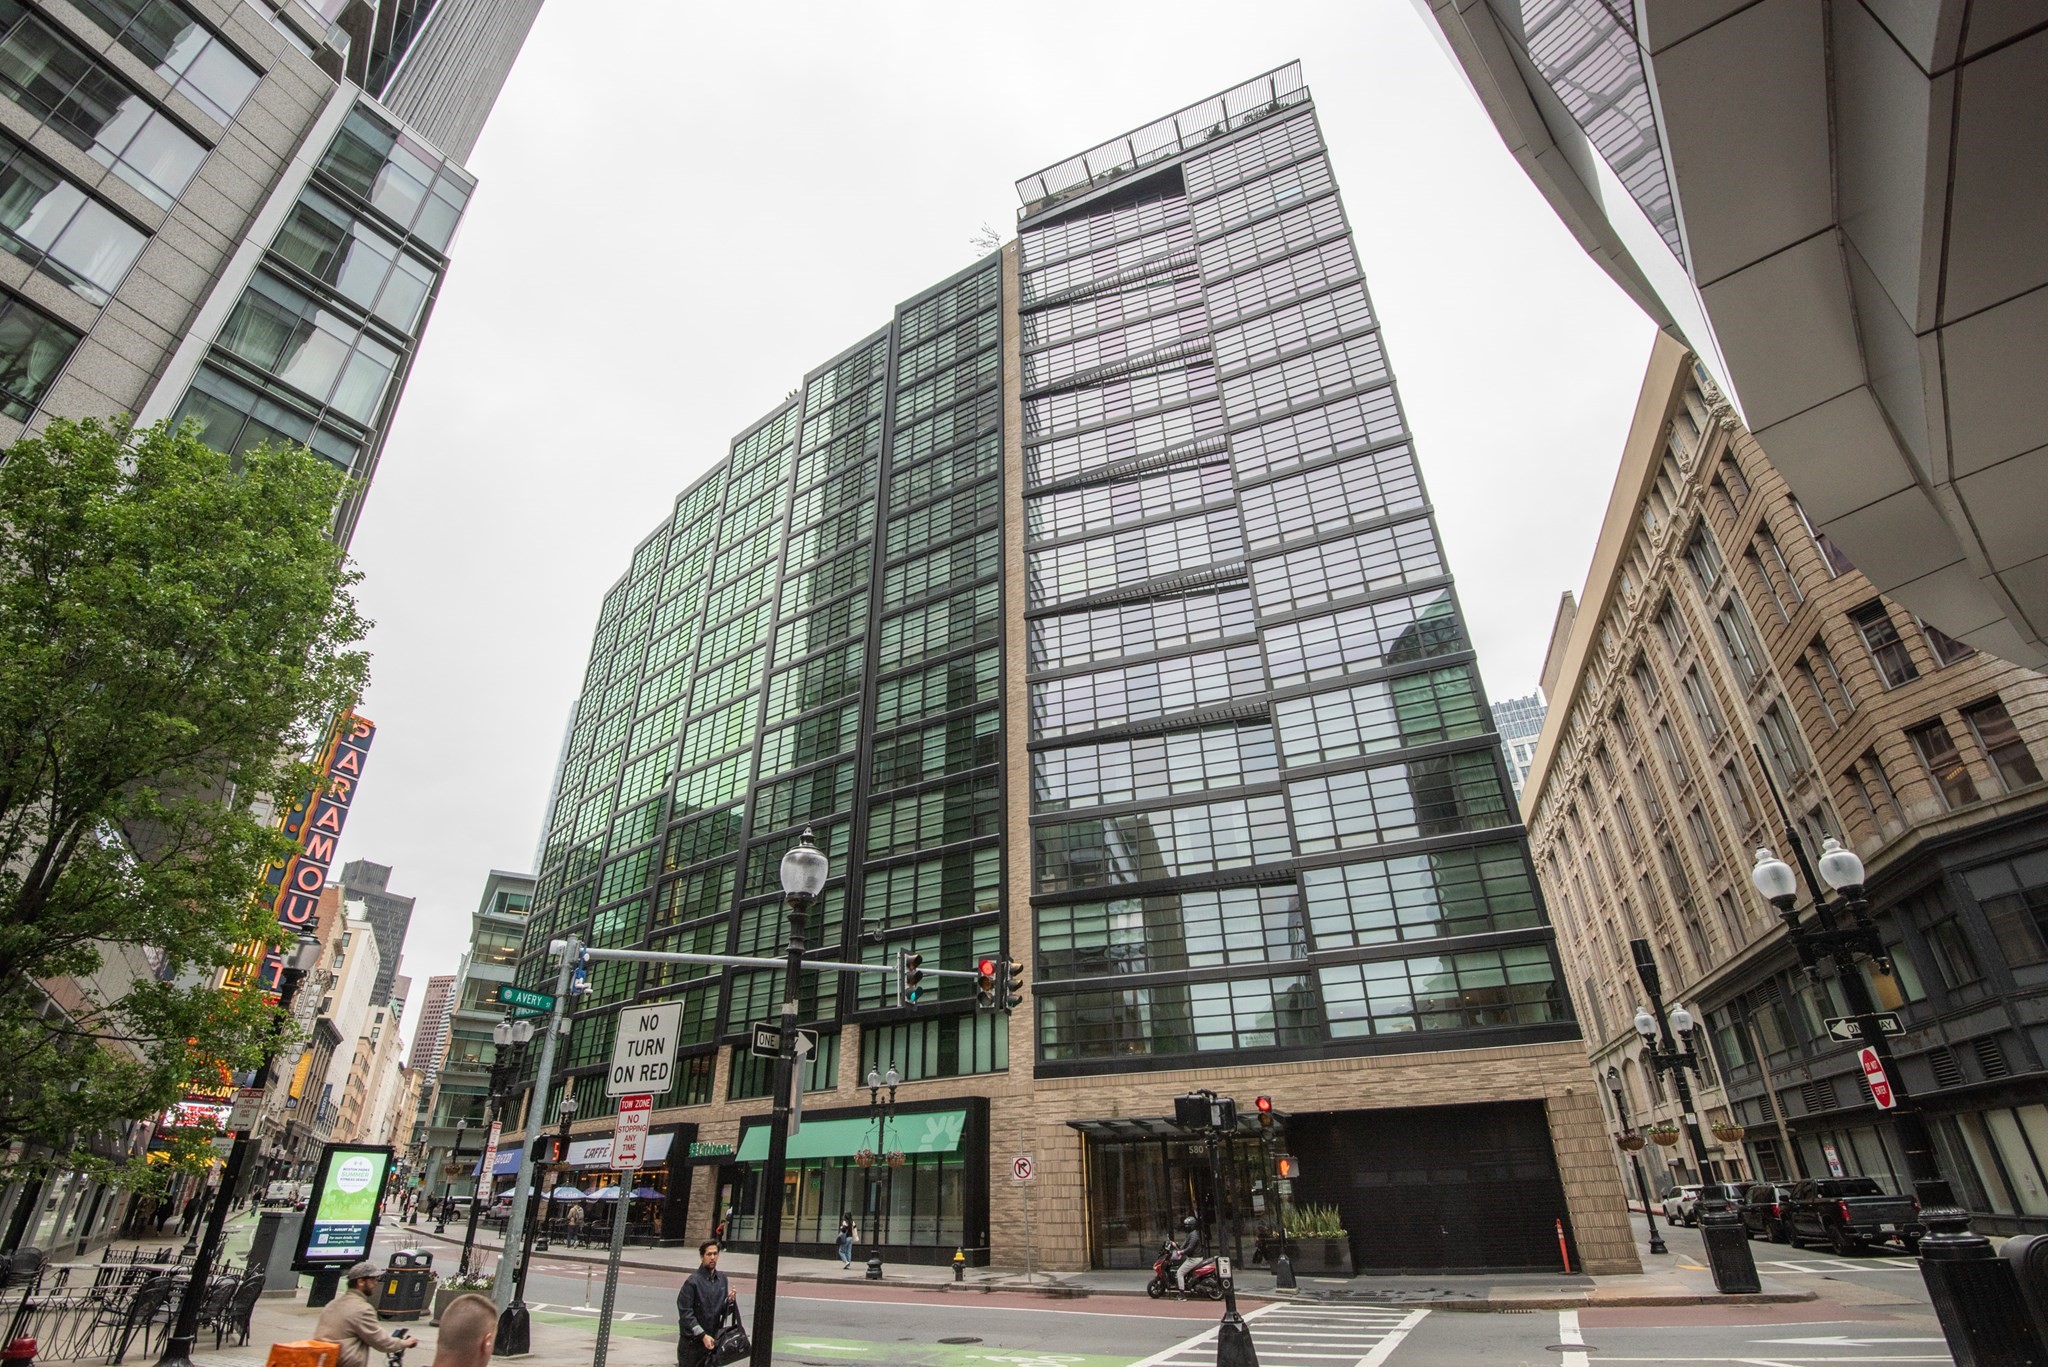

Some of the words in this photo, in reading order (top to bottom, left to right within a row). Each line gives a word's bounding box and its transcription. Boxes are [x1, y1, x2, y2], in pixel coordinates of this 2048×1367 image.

[270, 722, 370, 990] PARAMOUT
[515, 991, 543, 1006] AVERY
[639, 1014, 659, 1032] NO
[759, 1033, 776, 1047] ONE
[628, 1037, 665, 1057] TURN
[614, 1065, 635, 1083] ON
[640, 1062, 669, 1081] RED
[1865, 1062, 1872, 1072] DO
[1870, 1060, 1878, 1070] NOT
[1875, 1085, 1887, 1095] ENTER
[622, 1101, 634, 1109] TOW
[635, 1099, 651, 1108] ZONE
[627, 1114, 640, 1124] NO
[617, 1125, 647, 1133] STOPPING
[624, 1134, 637, 1142] ANY
[552, 1142, 560, 1160] 5
[1188, 1146, 1204, 1154] 580
